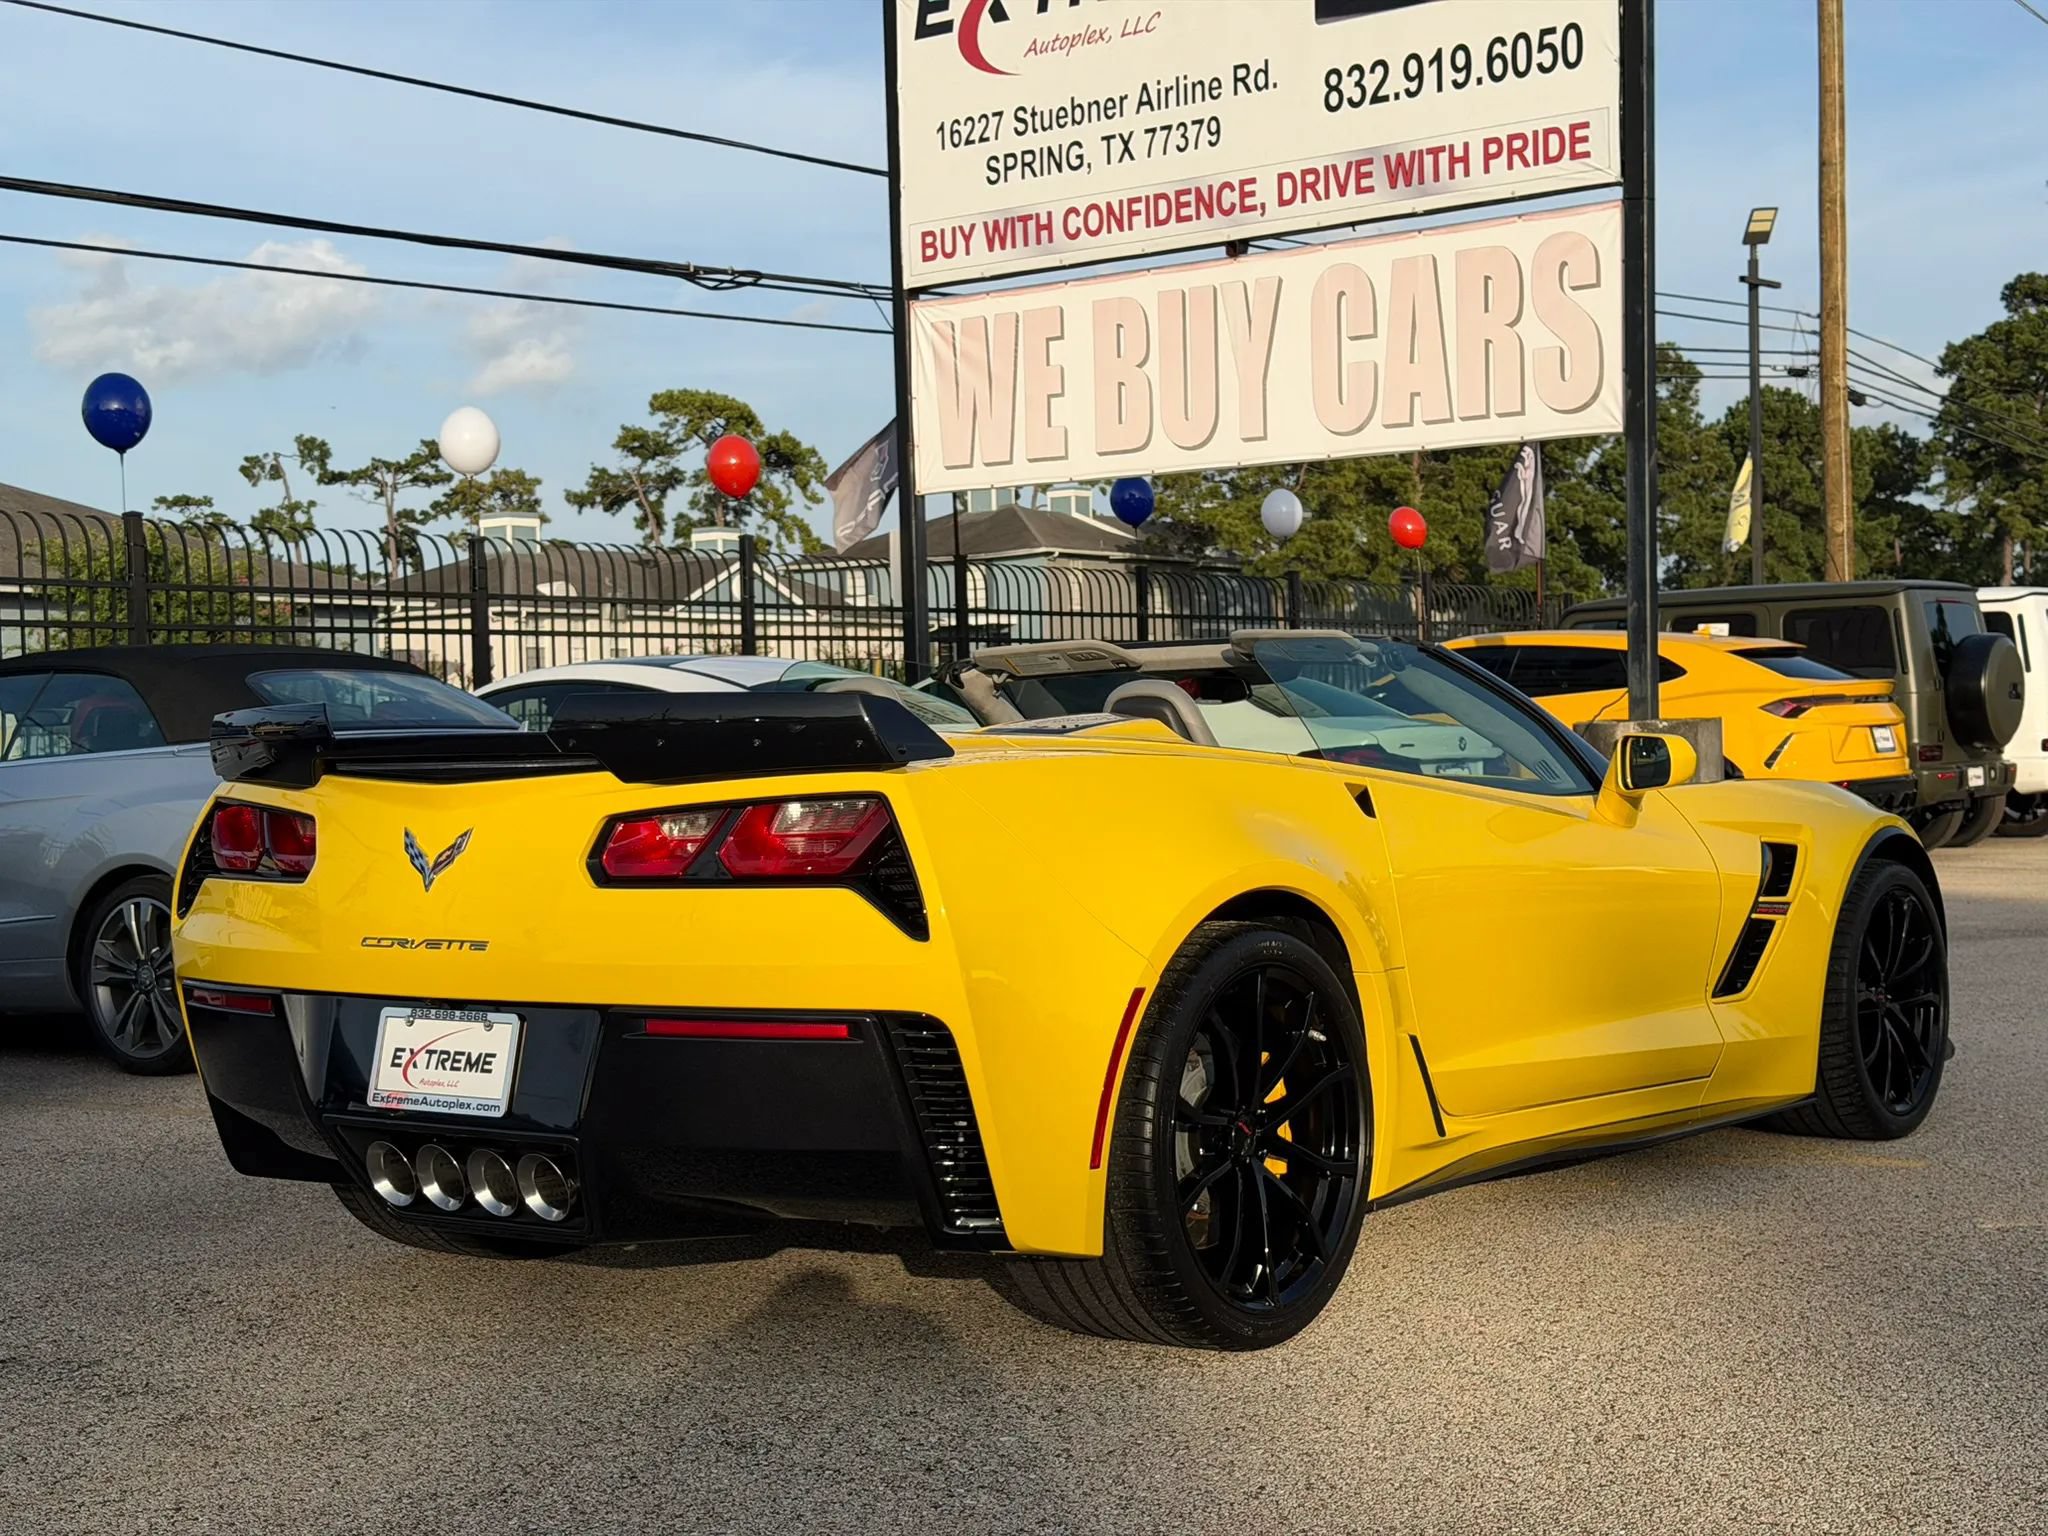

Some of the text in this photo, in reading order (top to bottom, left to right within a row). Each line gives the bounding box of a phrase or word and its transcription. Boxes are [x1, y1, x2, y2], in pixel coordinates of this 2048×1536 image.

[1023, 23, 1112, 57] Autoplex,
[1120, 11, 1161, 38] LLC
[1323, 22, 1584, 113] 832.919.6050
[936, 58, 1278, 150] 16227 Stuebner Airline Rd.
[985, 116, 1221, 185] SPRING, TX 77379
[921, 121, 1591, 262] BUY WITH CONFIDENCE, DRIVE WITH PRIDE
[930, 231, 1605, 470] WE BUY CARS
[361, 936, 489, 951] CORVETTE
[410, 1008, 488, 1021] 832-698-2668
[390, 1047, 497, 1074] EXTREME
[372, 1092, 501, 1113] ExtremeAutoplex.com
